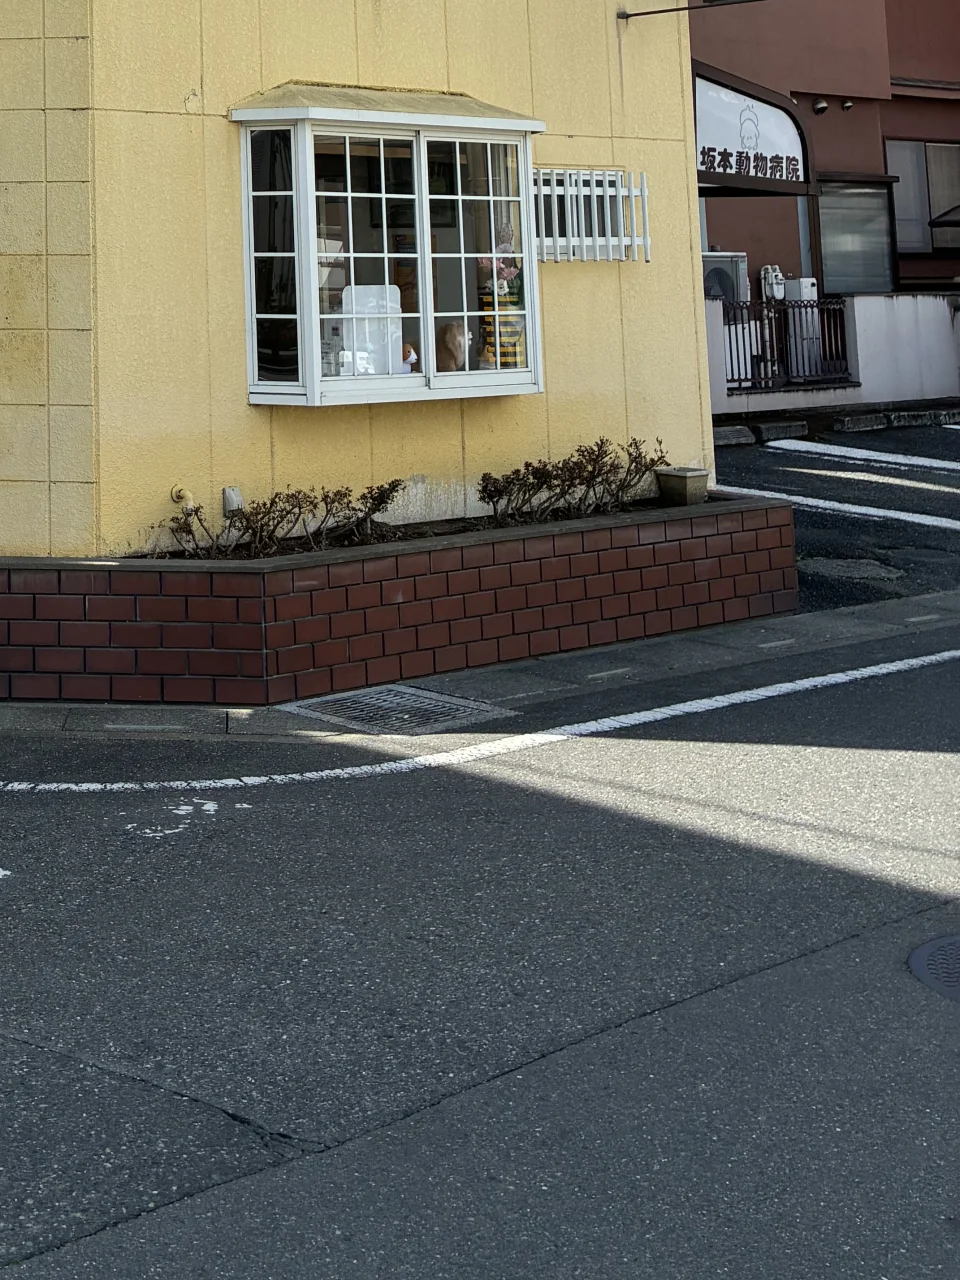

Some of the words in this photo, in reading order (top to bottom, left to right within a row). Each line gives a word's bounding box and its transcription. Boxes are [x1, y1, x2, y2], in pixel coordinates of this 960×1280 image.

[700, 146, 801, 181] 坂本動物病院
